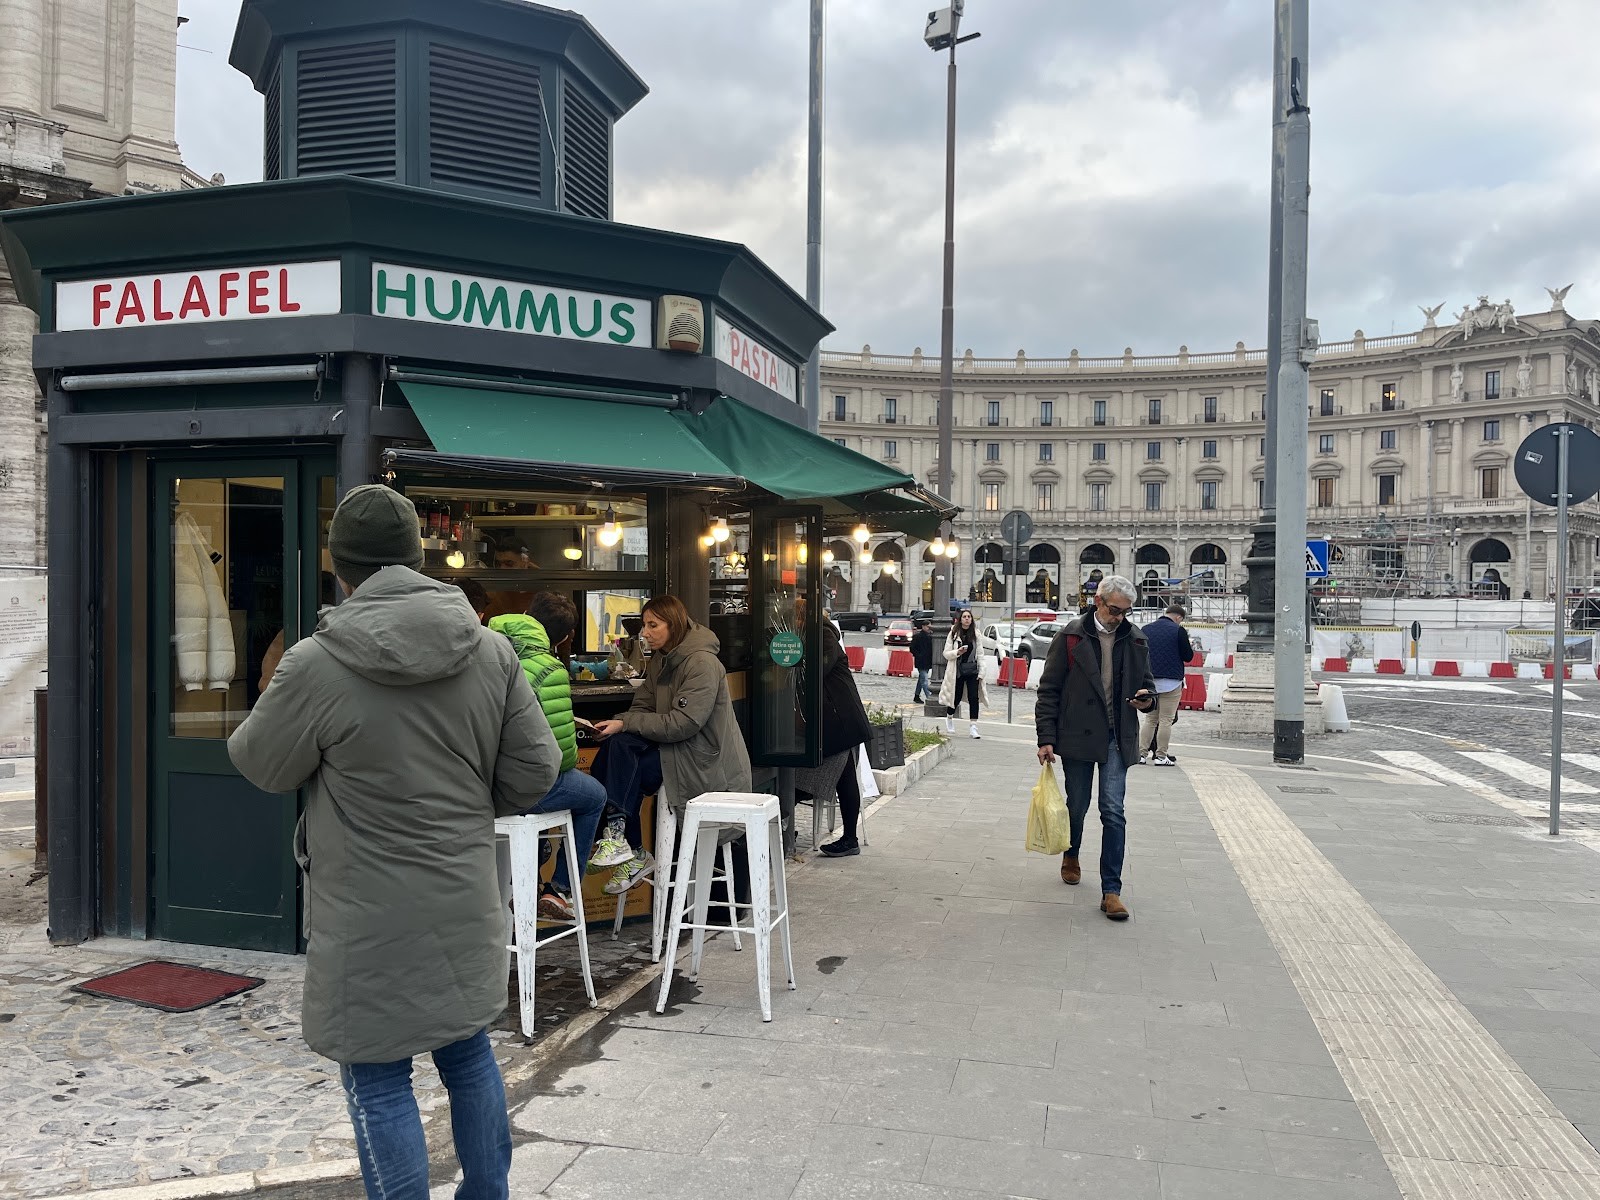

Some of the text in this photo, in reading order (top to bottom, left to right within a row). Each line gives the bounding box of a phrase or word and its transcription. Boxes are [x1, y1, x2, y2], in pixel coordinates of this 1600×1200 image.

[92, 268, 301, 326] FALAFEL
[376, 269, 636, 344] HUMMUS
[730, 330, 778, 391] PASTA
[788, 642, 796, 650] qui
